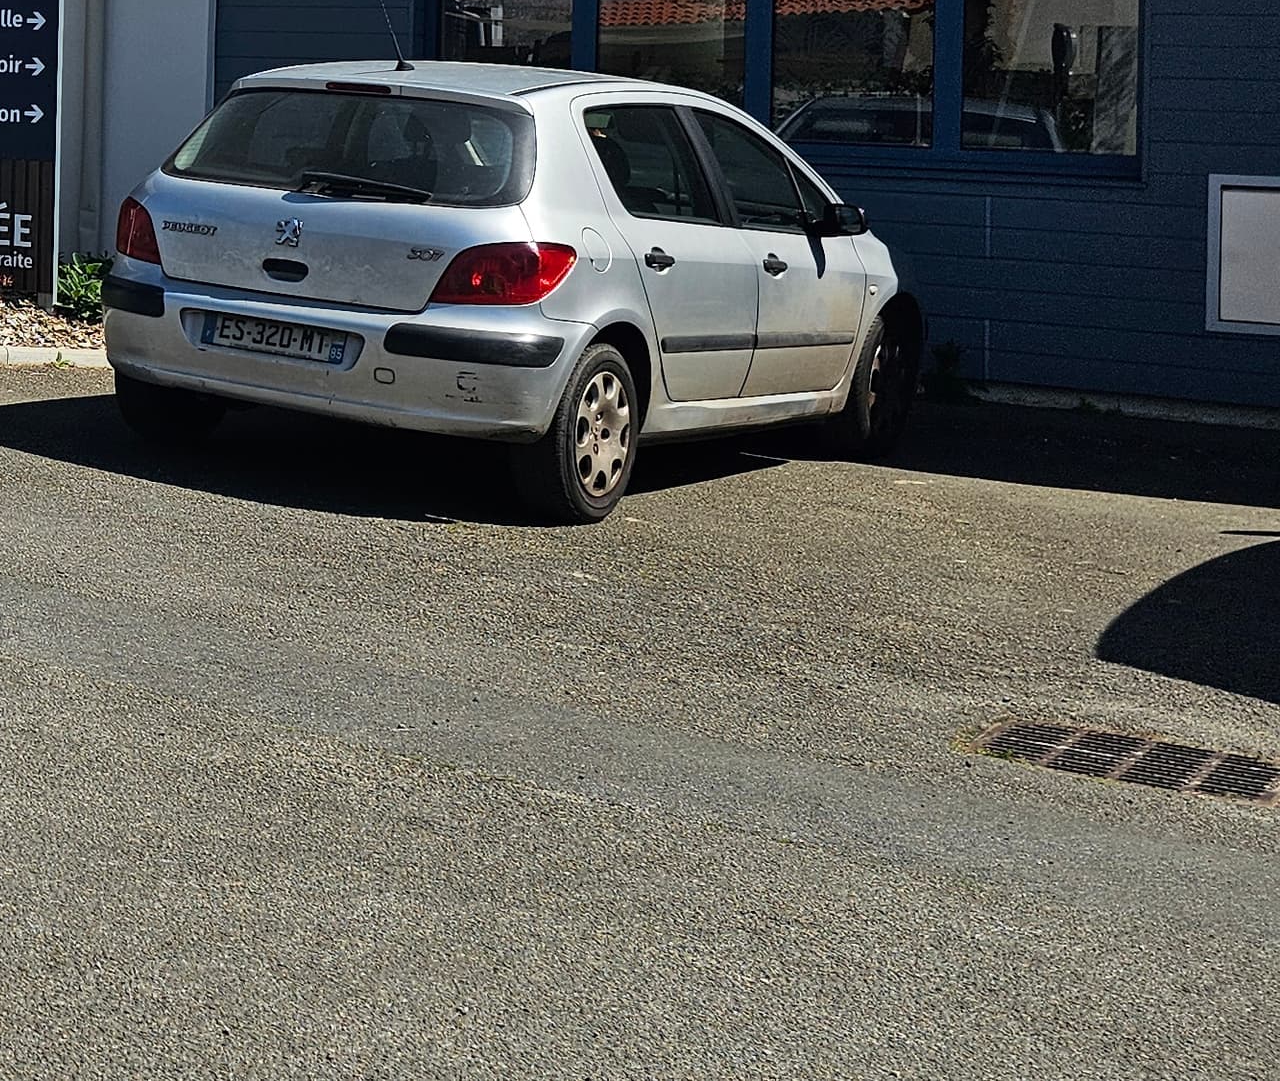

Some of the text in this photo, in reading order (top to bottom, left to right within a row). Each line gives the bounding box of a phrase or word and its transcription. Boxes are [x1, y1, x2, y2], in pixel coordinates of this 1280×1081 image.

[161, 220, 218, 236] PEUGEOT
[407, 248, 445, 261] 307
[329, 347, 343, 360] 85
